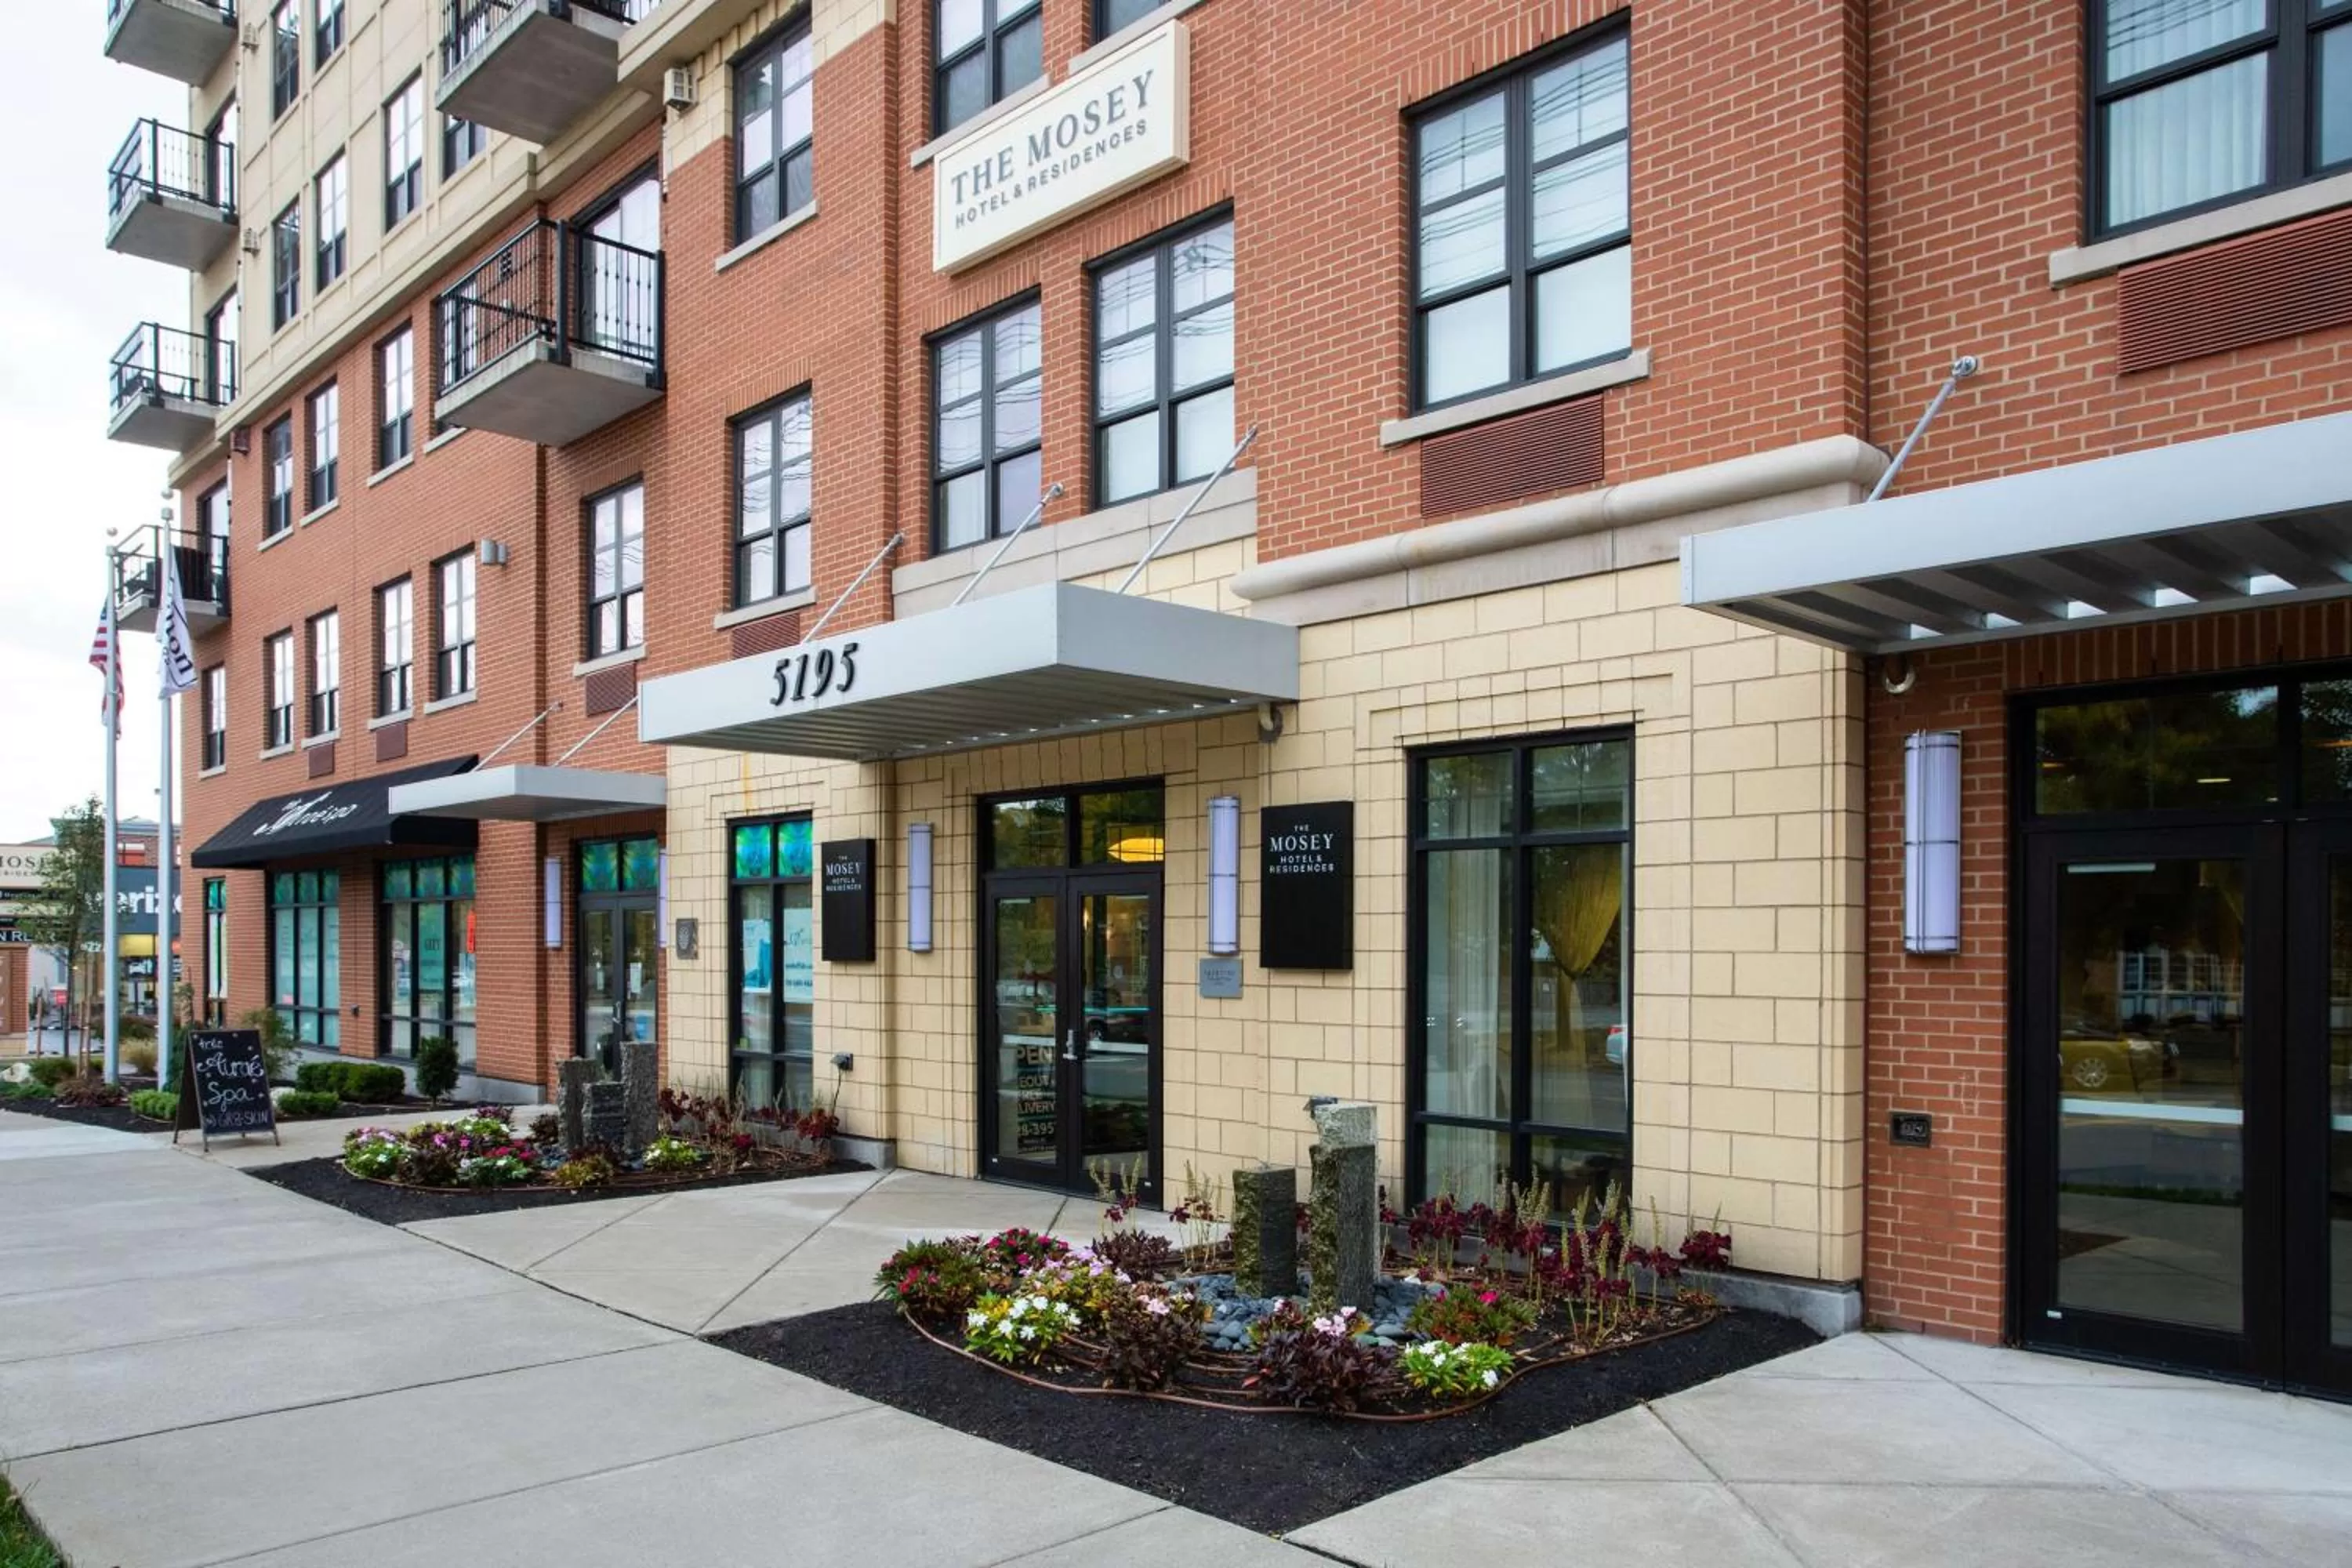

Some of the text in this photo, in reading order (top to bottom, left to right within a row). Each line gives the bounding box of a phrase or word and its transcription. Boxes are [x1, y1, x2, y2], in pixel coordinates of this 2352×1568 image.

[951, 69, 1154, 205] THE MOSEY
[955, 118, 1147, 229] HOTEL & RESIDENCES
[769, 642, 859, 706] 5195
[1269, 833, 1334, 852] MOSEY
[826, 862, 862, 876] MOSEY
[1269, 863, 1334, 874] RESIDENCES
[1280, 855, 1314, 863] HOTEL
[207, 1081, 256, 1112] Spa
